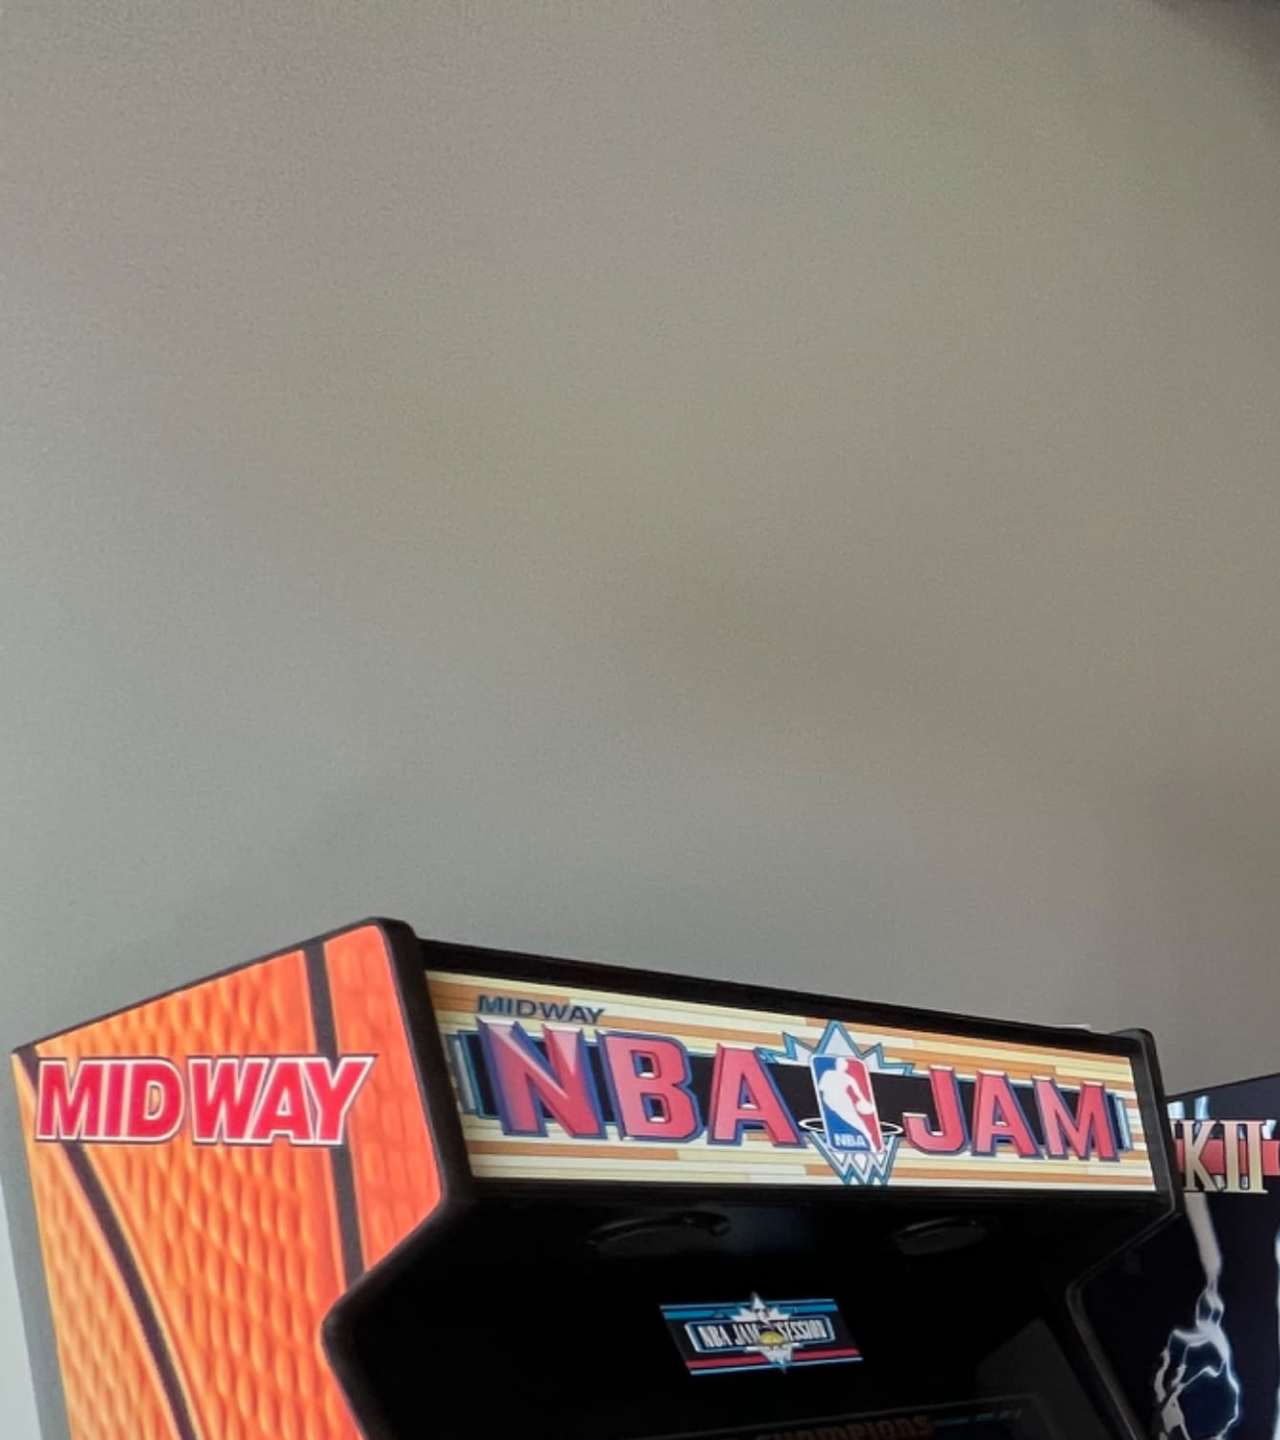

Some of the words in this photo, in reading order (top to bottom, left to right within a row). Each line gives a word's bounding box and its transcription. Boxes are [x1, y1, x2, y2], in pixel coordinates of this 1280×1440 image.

[477, 994, 604, 1024] MIDWAY
[34, 1053, 378, 1146] MIDWAY
[475, 1016, 808, 1150] NBA
[900, 1066, 1121, 1162] JAM
[833, 1131, 868, 1149] NBA
[698, 1324, 732, 1348] NBA
